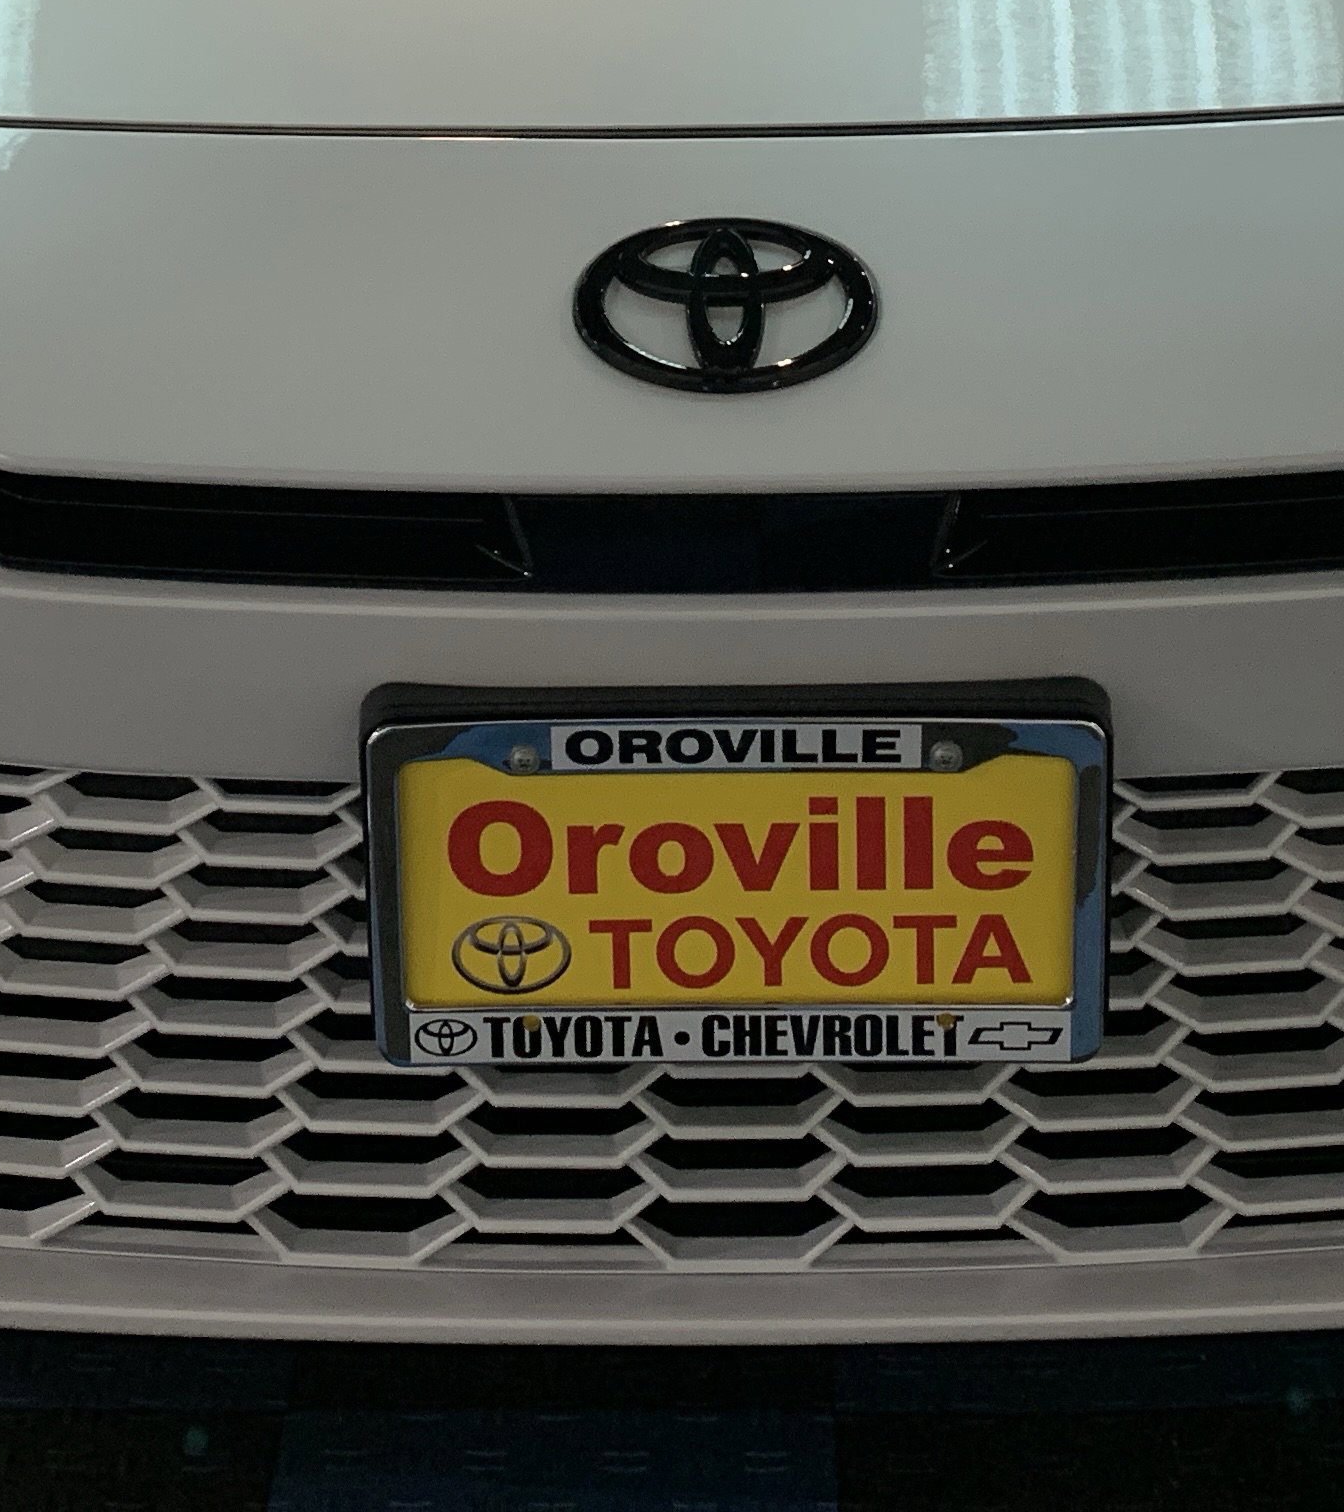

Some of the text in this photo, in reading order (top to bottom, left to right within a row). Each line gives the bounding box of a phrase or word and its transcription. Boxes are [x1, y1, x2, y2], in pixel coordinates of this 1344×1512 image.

[564, 728, 904, 767] OROVILLE
[447, 795, 1036, 898] Oroville
[588, 913, 1035, 990] TOYOTA
[482, 1013, 965, 1058] TOYOTA CHEVROLET
